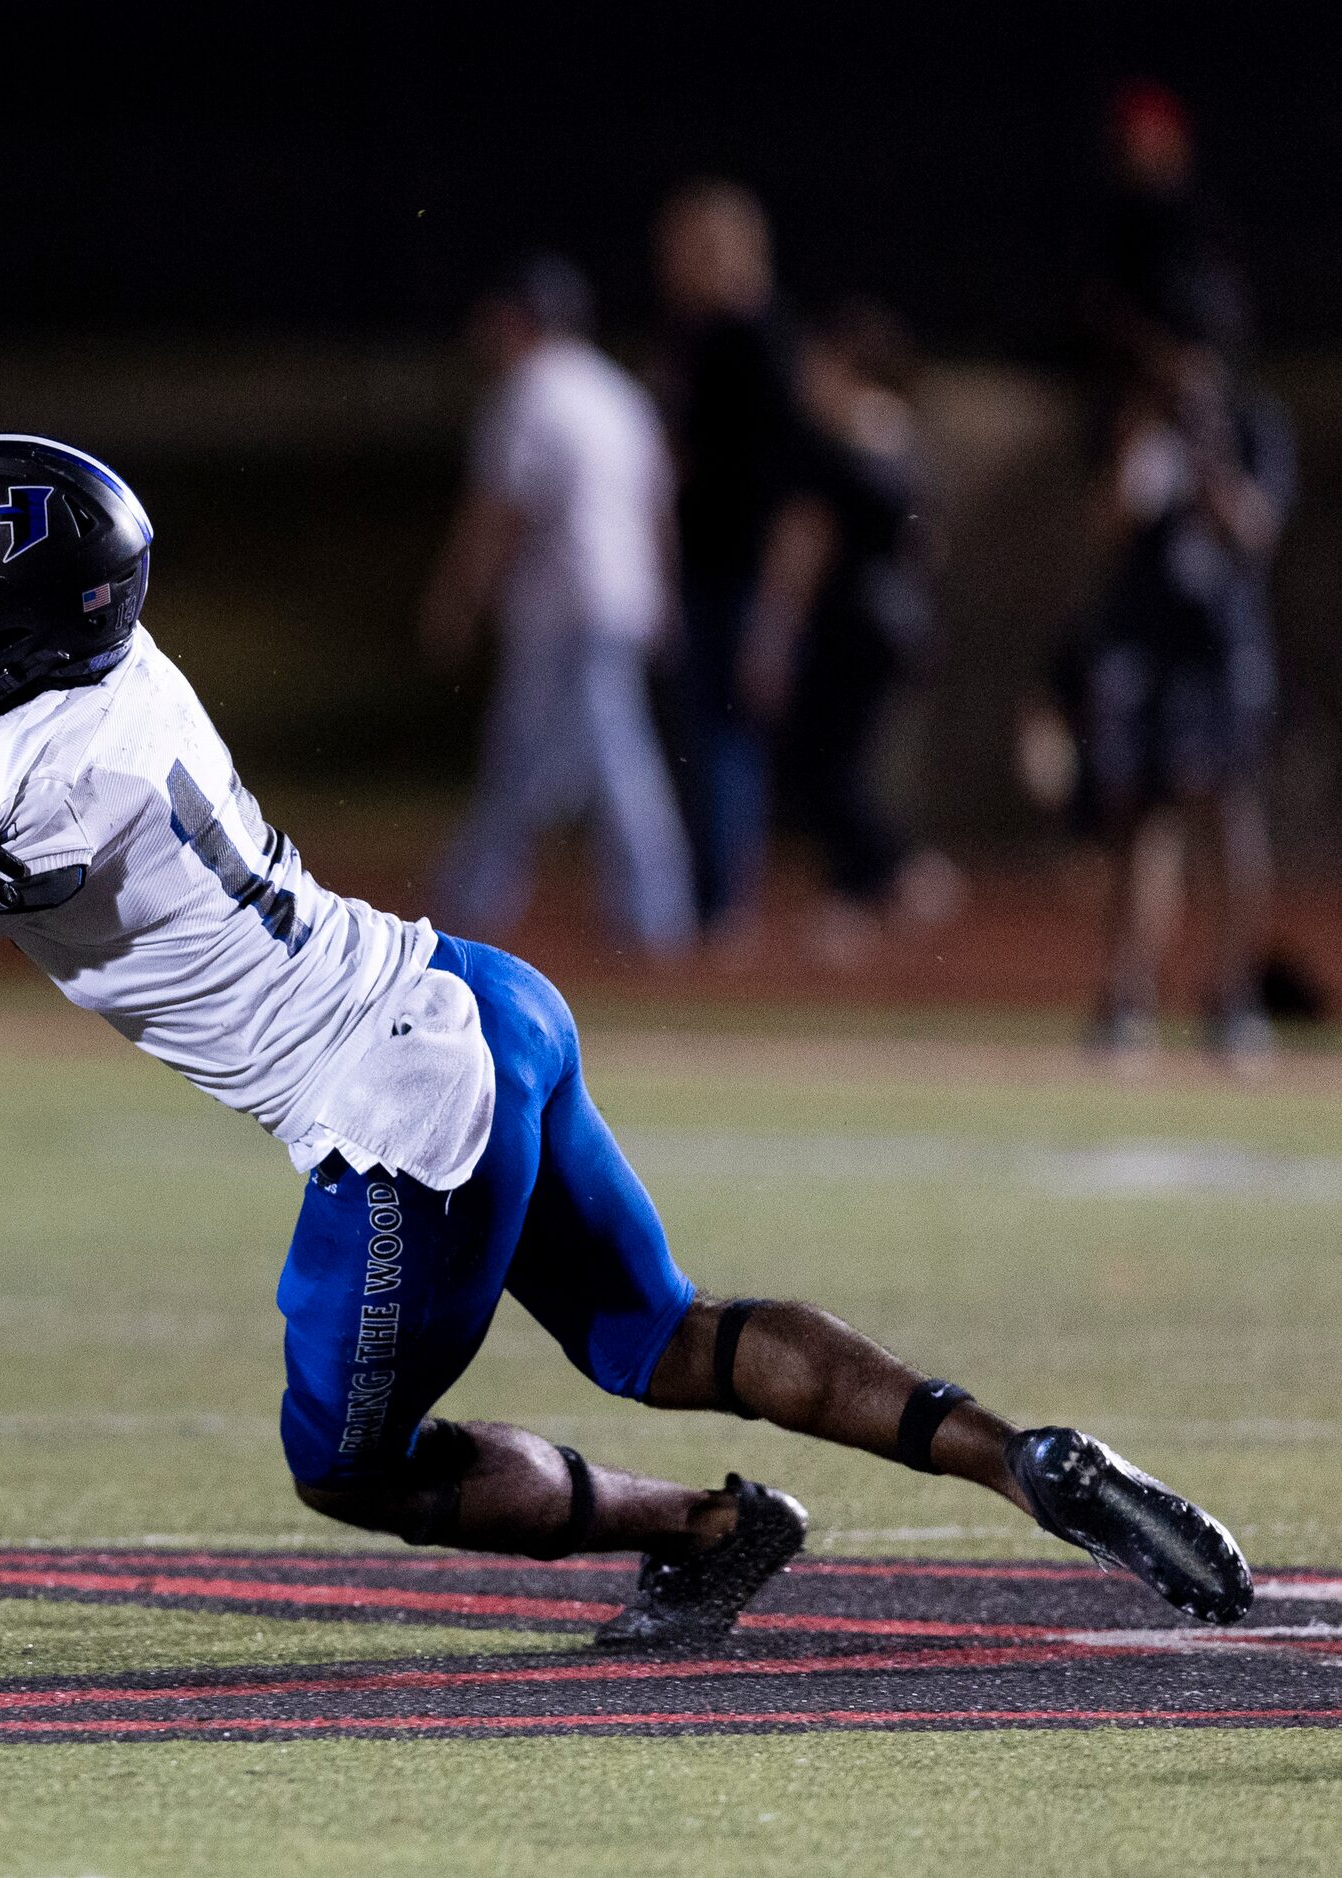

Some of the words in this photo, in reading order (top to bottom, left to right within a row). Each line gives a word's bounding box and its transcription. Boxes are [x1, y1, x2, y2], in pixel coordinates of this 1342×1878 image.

[364, 1182, 403, 1295] WOOD
[355, 1303, 400, 1363] THE
[338, 1369, 397, 1453] BRING
